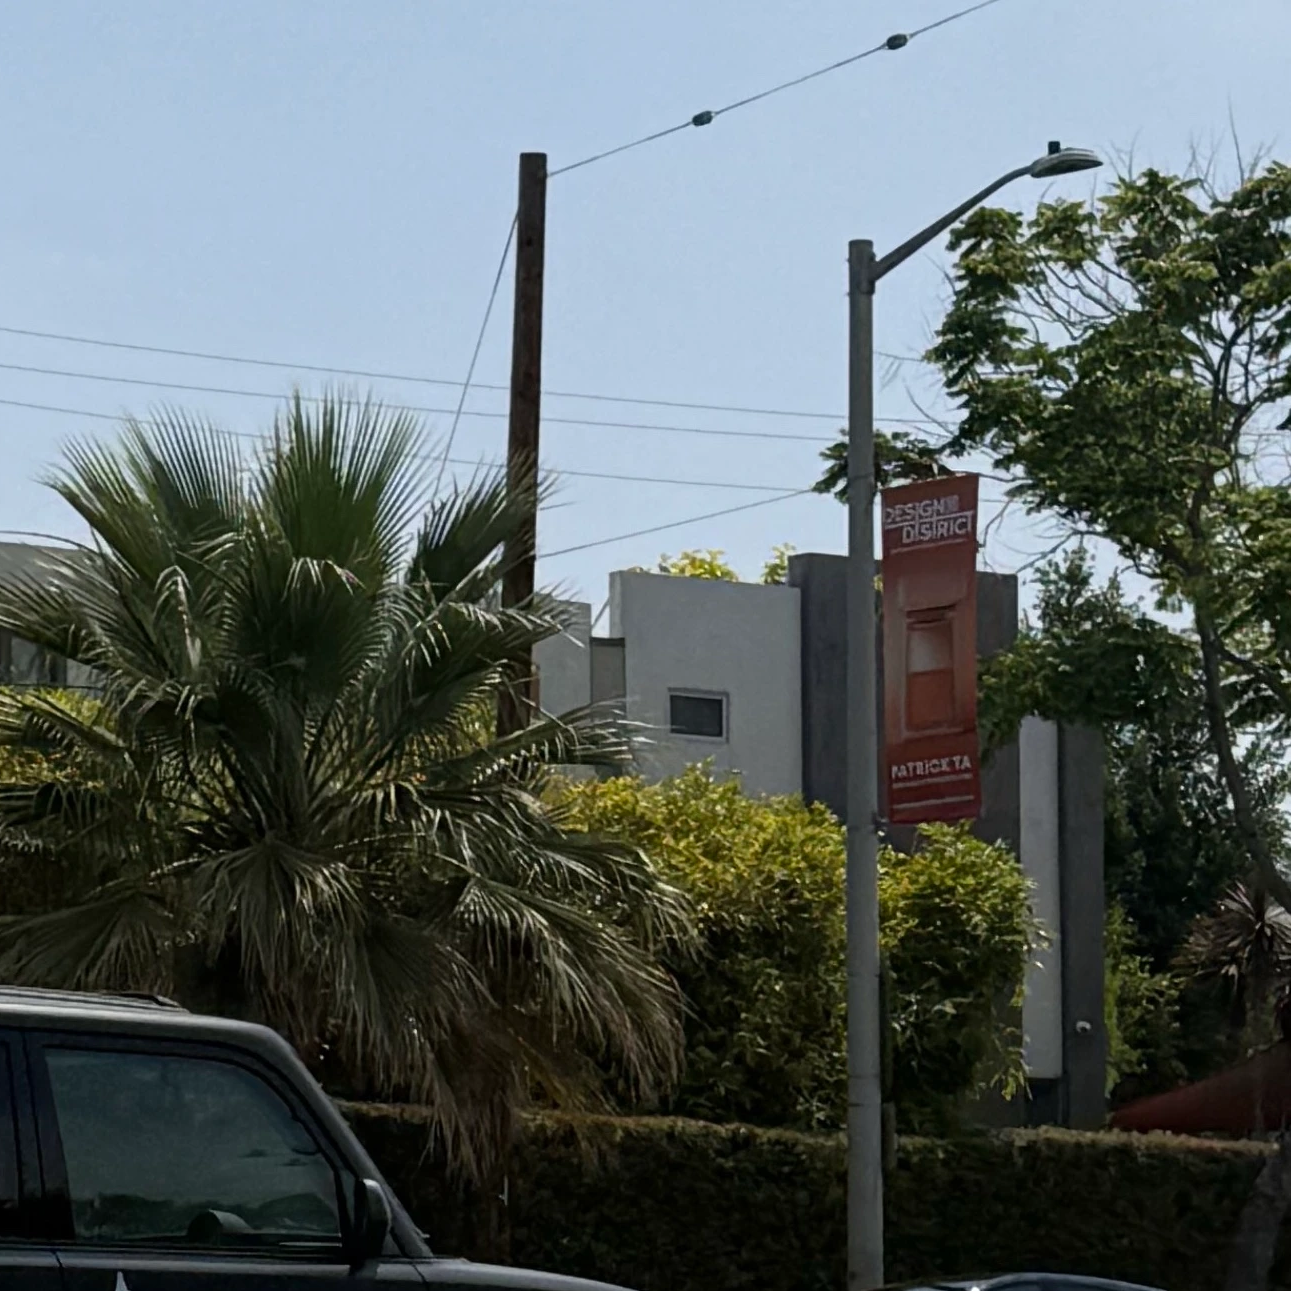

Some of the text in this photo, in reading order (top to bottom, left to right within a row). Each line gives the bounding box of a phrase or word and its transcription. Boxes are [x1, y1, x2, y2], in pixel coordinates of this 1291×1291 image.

[884, 499, 945, 523] DESIGN
[902, 512, 972, 544] DISTRICT
[891, 755, 972, 779] PATRICK TA
